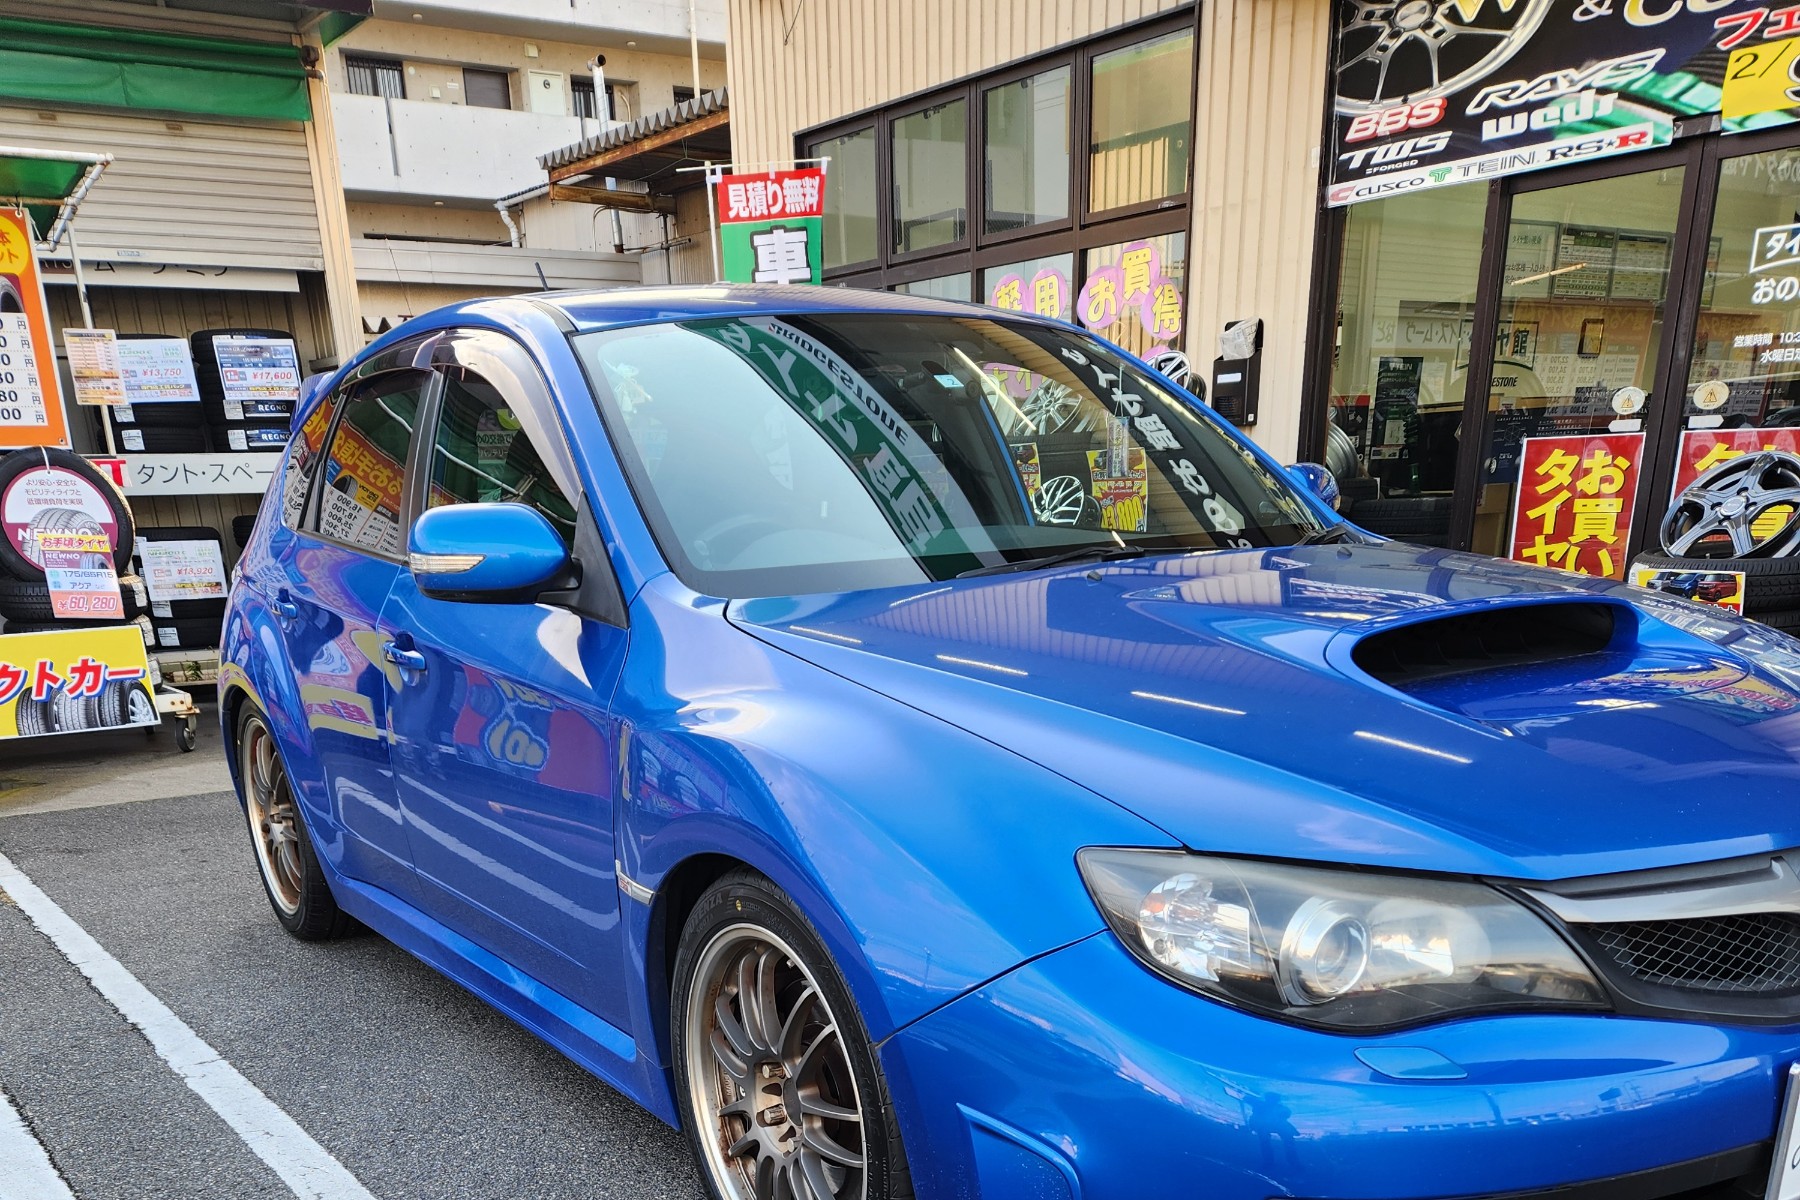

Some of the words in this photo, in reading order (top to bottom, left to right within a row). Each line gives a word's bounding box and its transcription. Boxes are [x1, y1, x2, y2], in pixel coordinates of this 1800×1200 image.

[1464, 48, 1667, 116] RAYS
[1345, 97, 1448, 143] BBS
[1339, 130, 1453, 170] TWS
[1365, 159, 1419, 175] FORGED
[1457, 151, 1536, 177] TEIN
[1354, 177, 1426, 200] CUSCO
[727, 176, 820, 219] 見積り無料
[1732, 332, 1774, 349] 営業時間
[142, 368, 182, 378] ¥13,750
[252, 371, 293, 381] ¥17,600
[257, 404, 287, 412] REGNO
[261, 433, 291, 441] REGNO
[26, 479, 77, 487] より安心・安全な
[42, 537, 106, 550] お手頃タイヤ
[63, 570, 114, 579] 175/65R15
